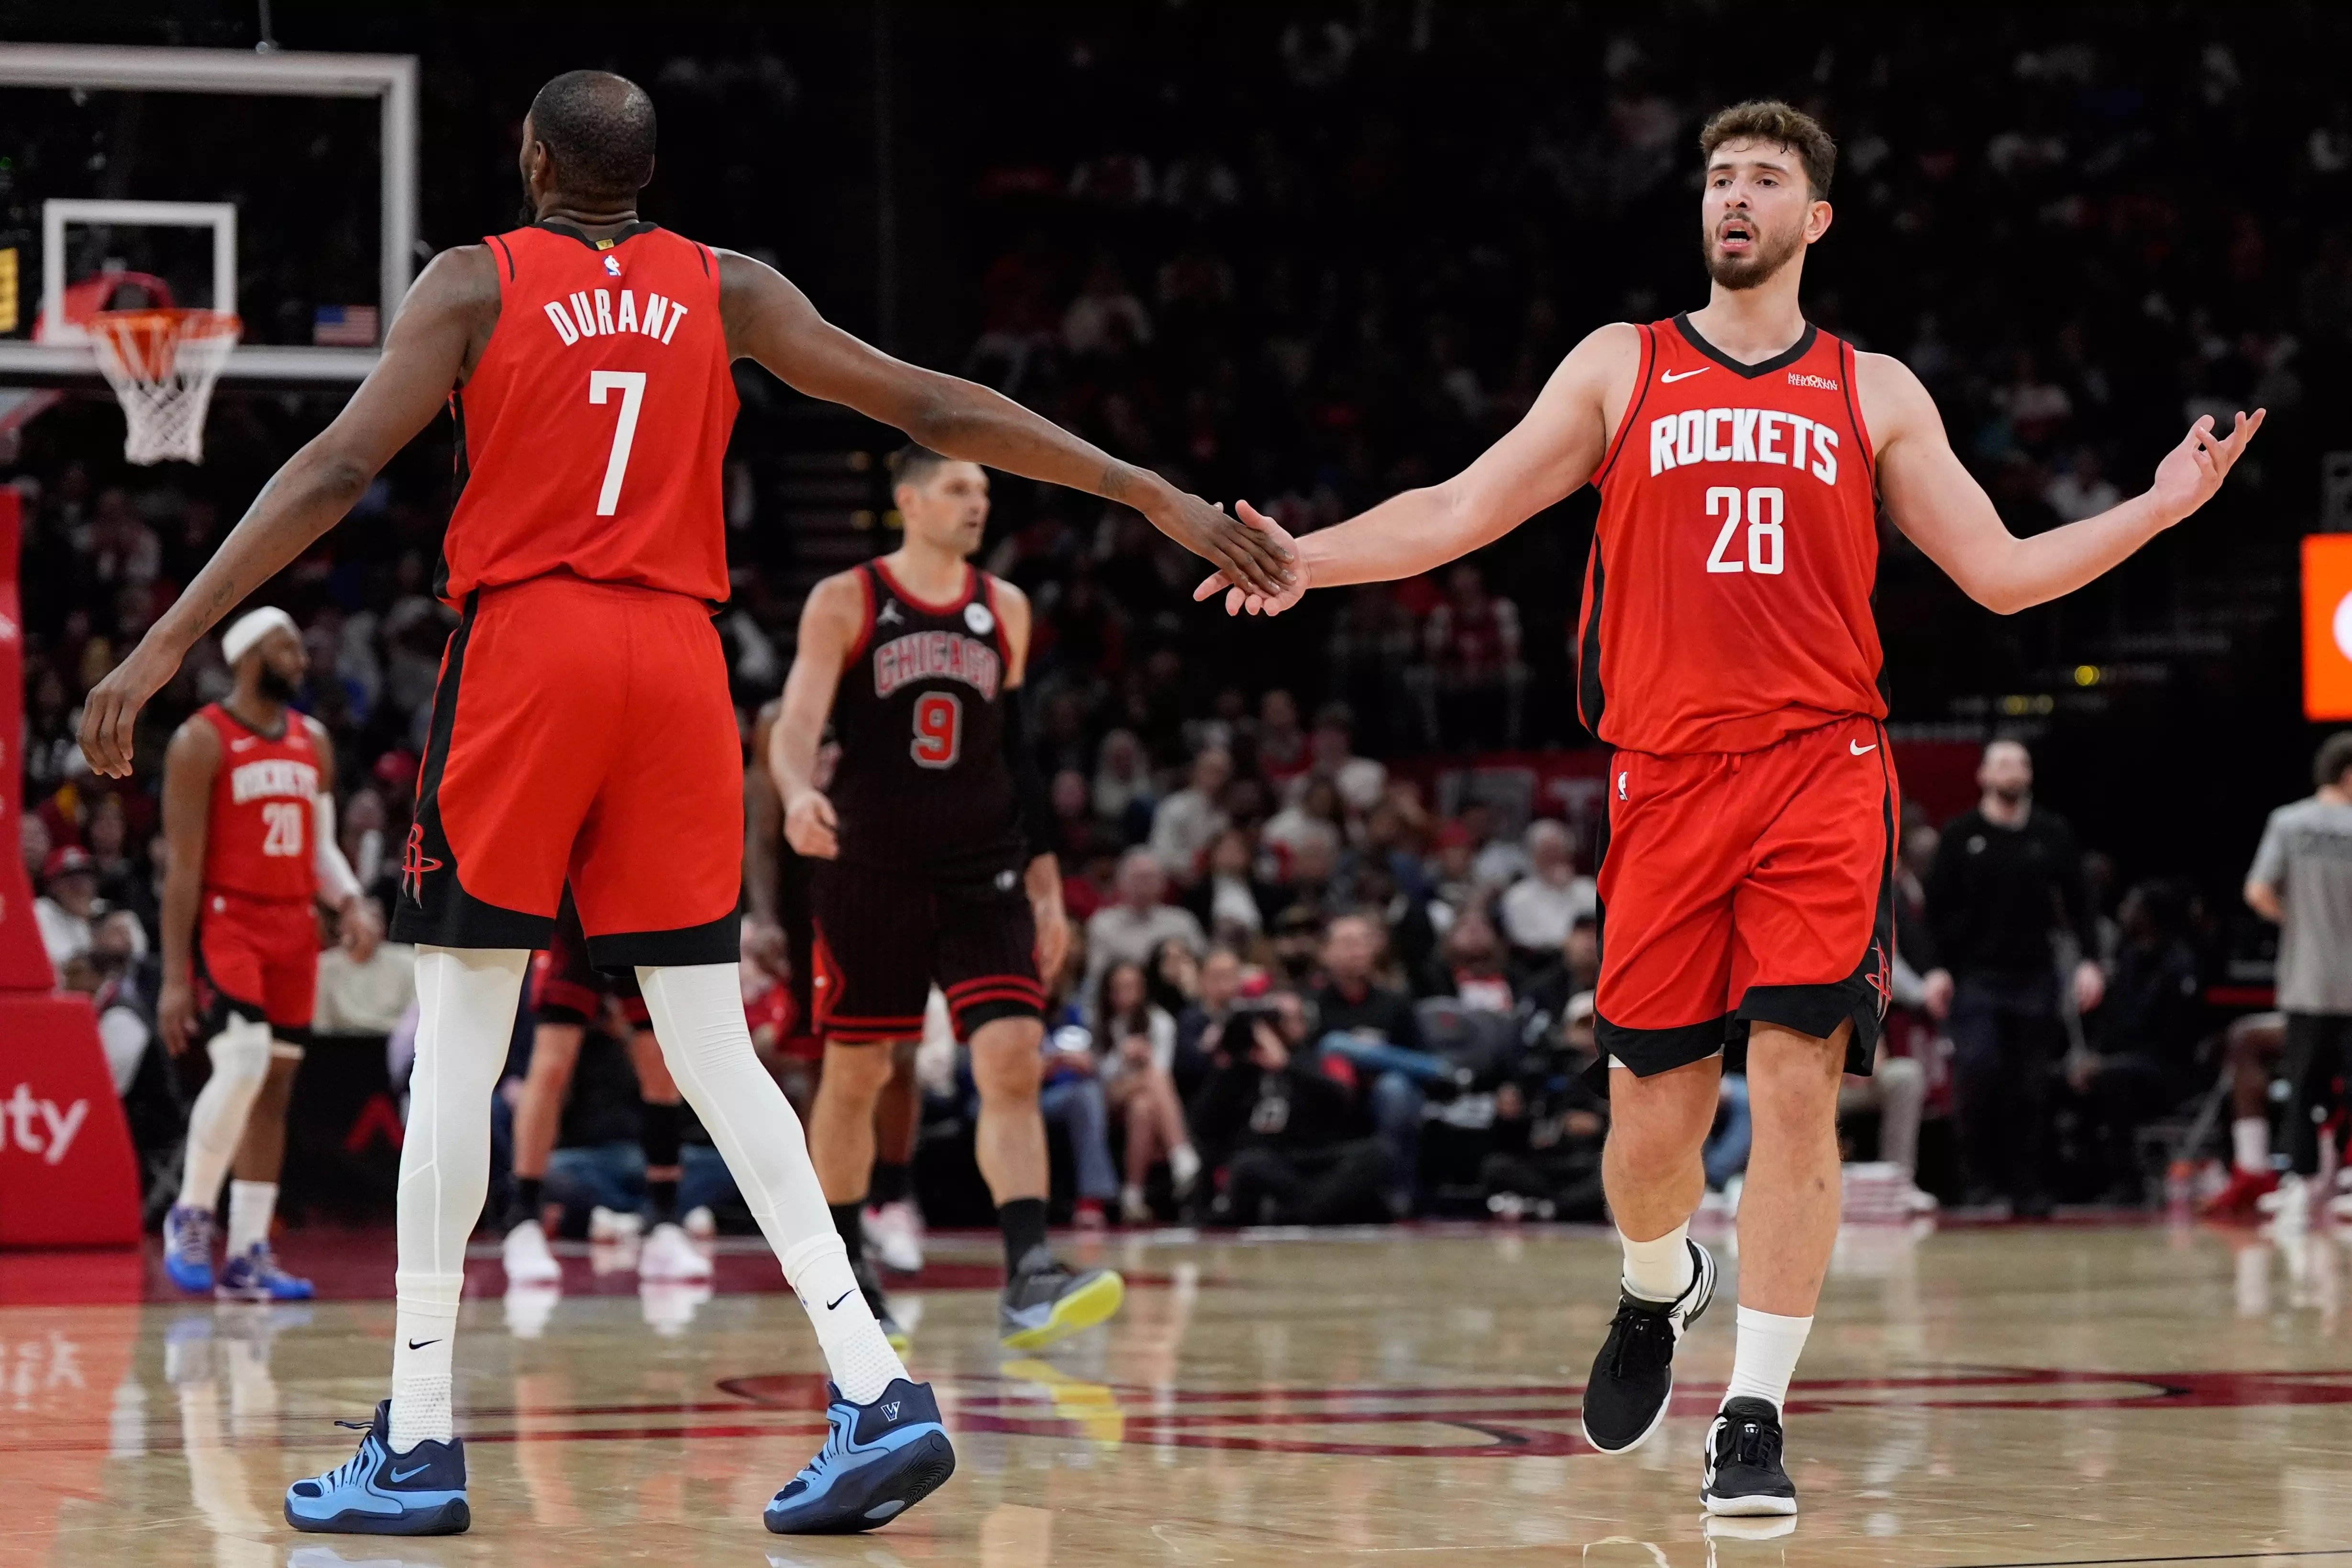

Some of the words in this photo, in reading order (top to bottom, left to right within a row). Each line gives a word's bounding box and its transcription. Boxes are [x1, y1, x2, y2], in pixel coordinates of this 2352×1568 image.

[543, 288, 688, 346] DURANT
[1788, 372, 1838, 386] MEMORIAL
[1788, 377, 1838, 391] HERMANN
[589, 370, 646, 516] 7
[1650, 408, 1839, 486] ROCKETS
[1706, 486, 1784, 574] 28
[873, 630, 1000, 703] CHICAGO
[911, 691, 963, 769] 9
[263, 802, 302, 857] 20
[0, 1082, 90, 1165] ty
